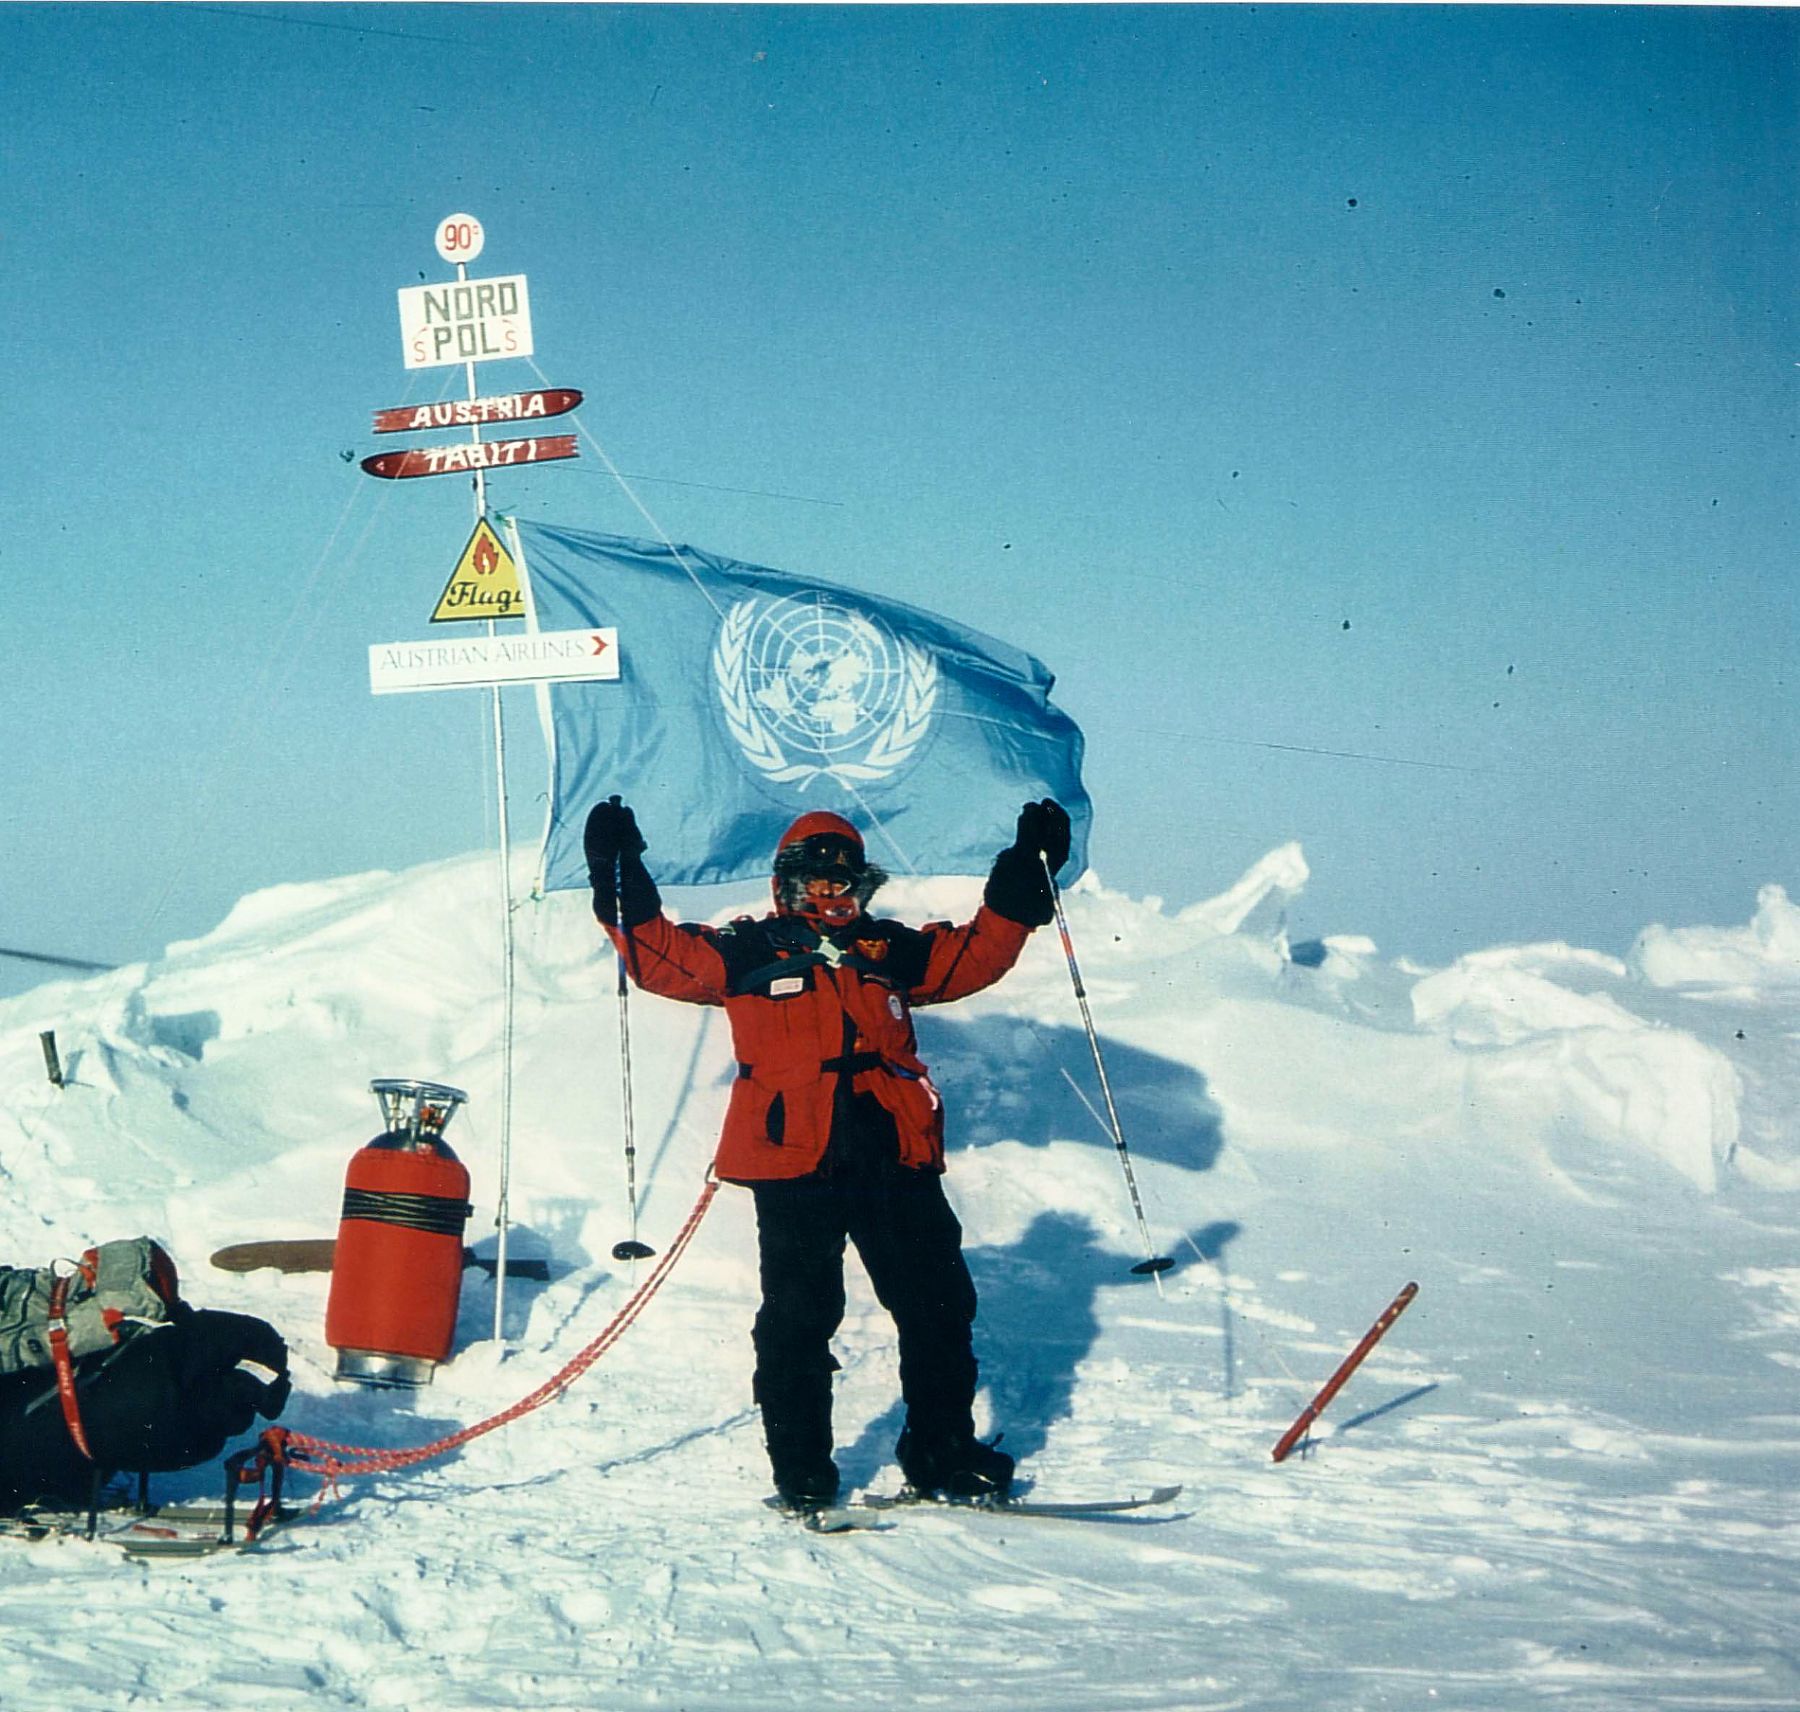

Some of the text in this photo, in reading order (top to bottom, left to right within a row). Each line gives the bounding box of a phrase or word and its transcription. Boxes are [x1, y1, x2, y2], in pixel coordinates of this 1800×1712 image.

[423, 281, 518, 324] NORD
[433, 322, 501, 360] POL
[409, 394, 547, 428] AUSTRIA
[424, 439, 538, 473] TAHITI
[380, 639, 586, 670] AUSTRIAN AIRLINES
